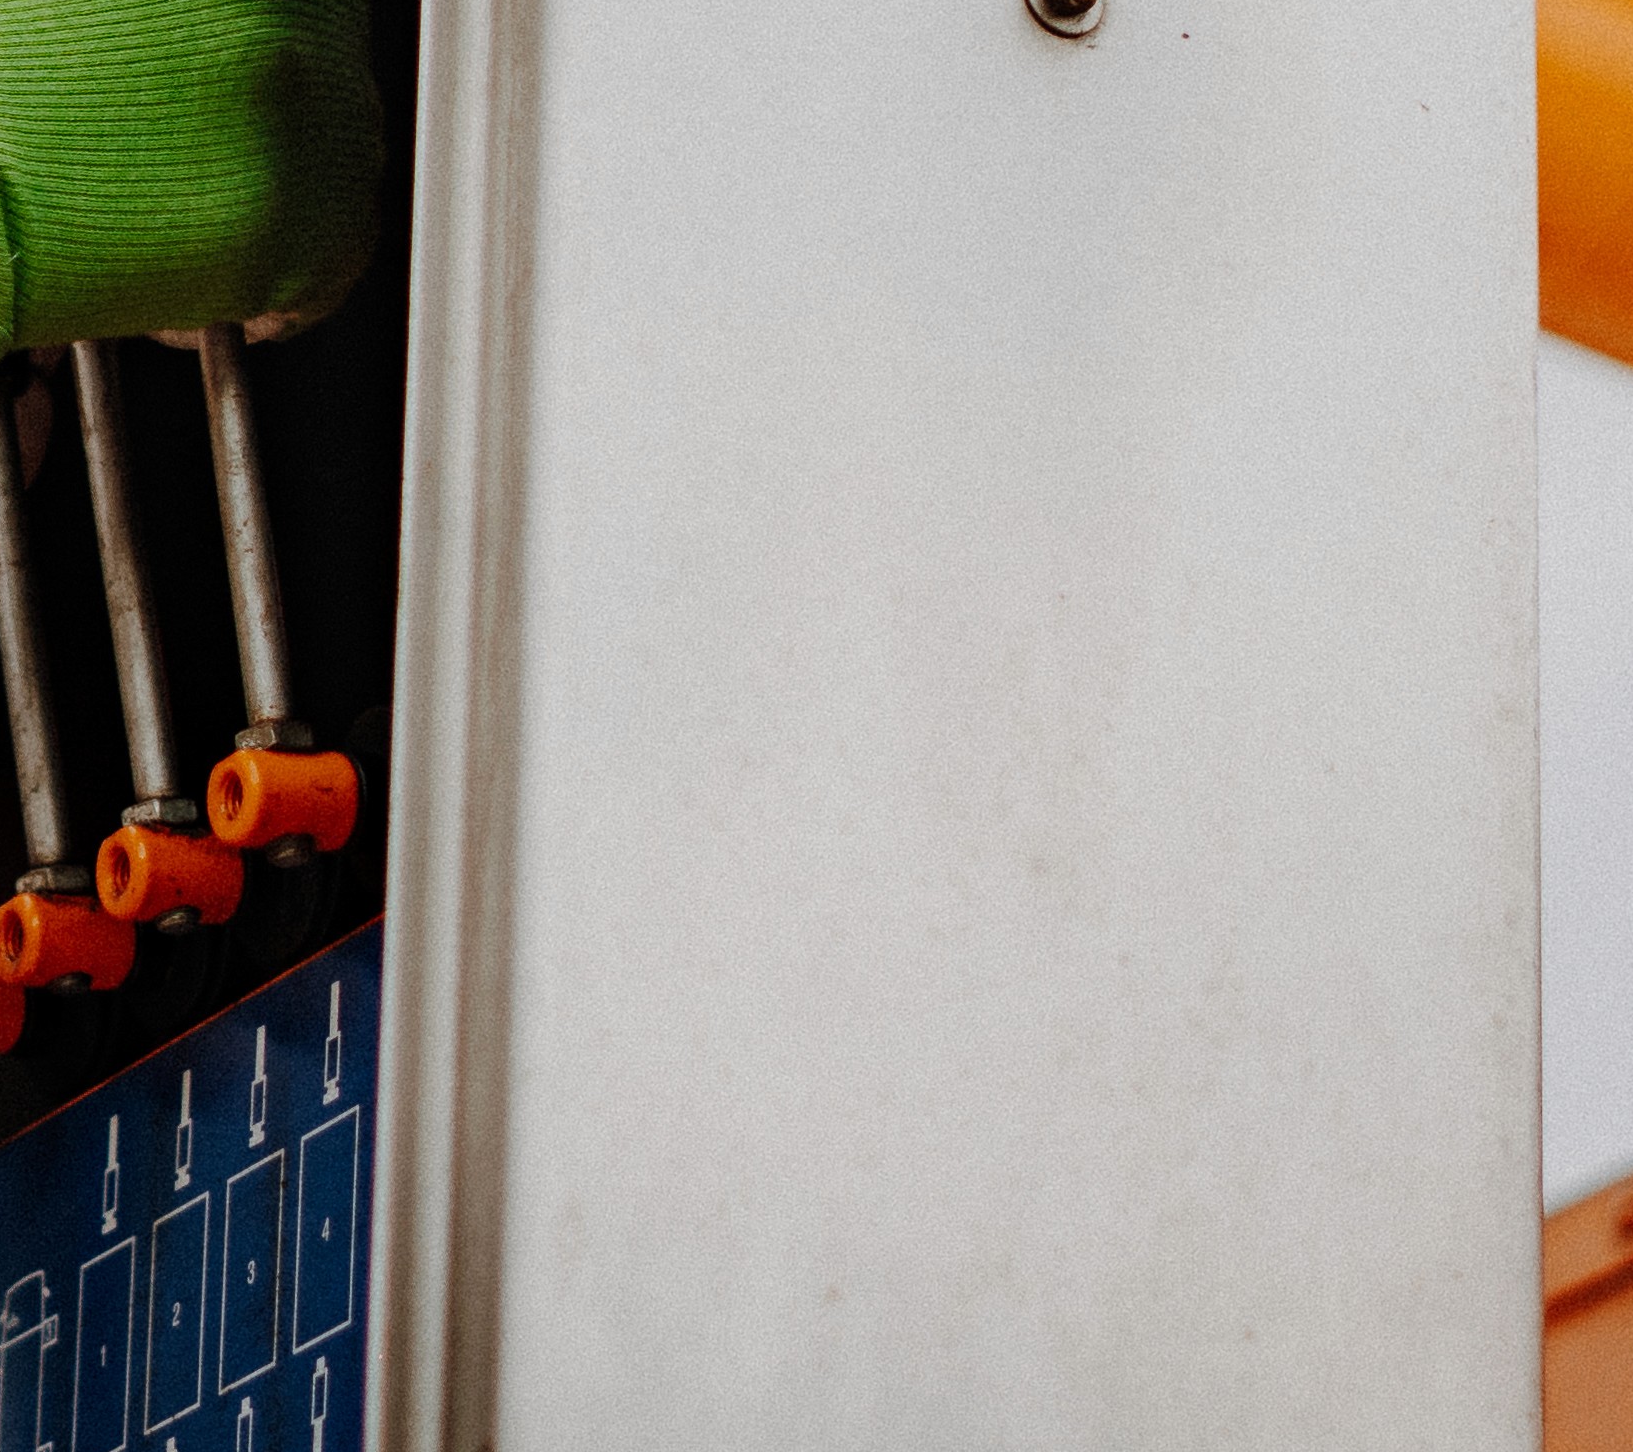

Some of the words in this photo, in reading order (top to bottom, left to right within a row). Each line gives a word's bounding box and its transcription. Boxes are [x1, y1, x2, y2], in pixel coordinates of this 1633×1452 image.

[100, 1345, 106, 1367] 1
[172, 1302, 181, 1327] 2
[247, 1259, 256, 1285] 3
[321, 1217, 330, 1242] 4
